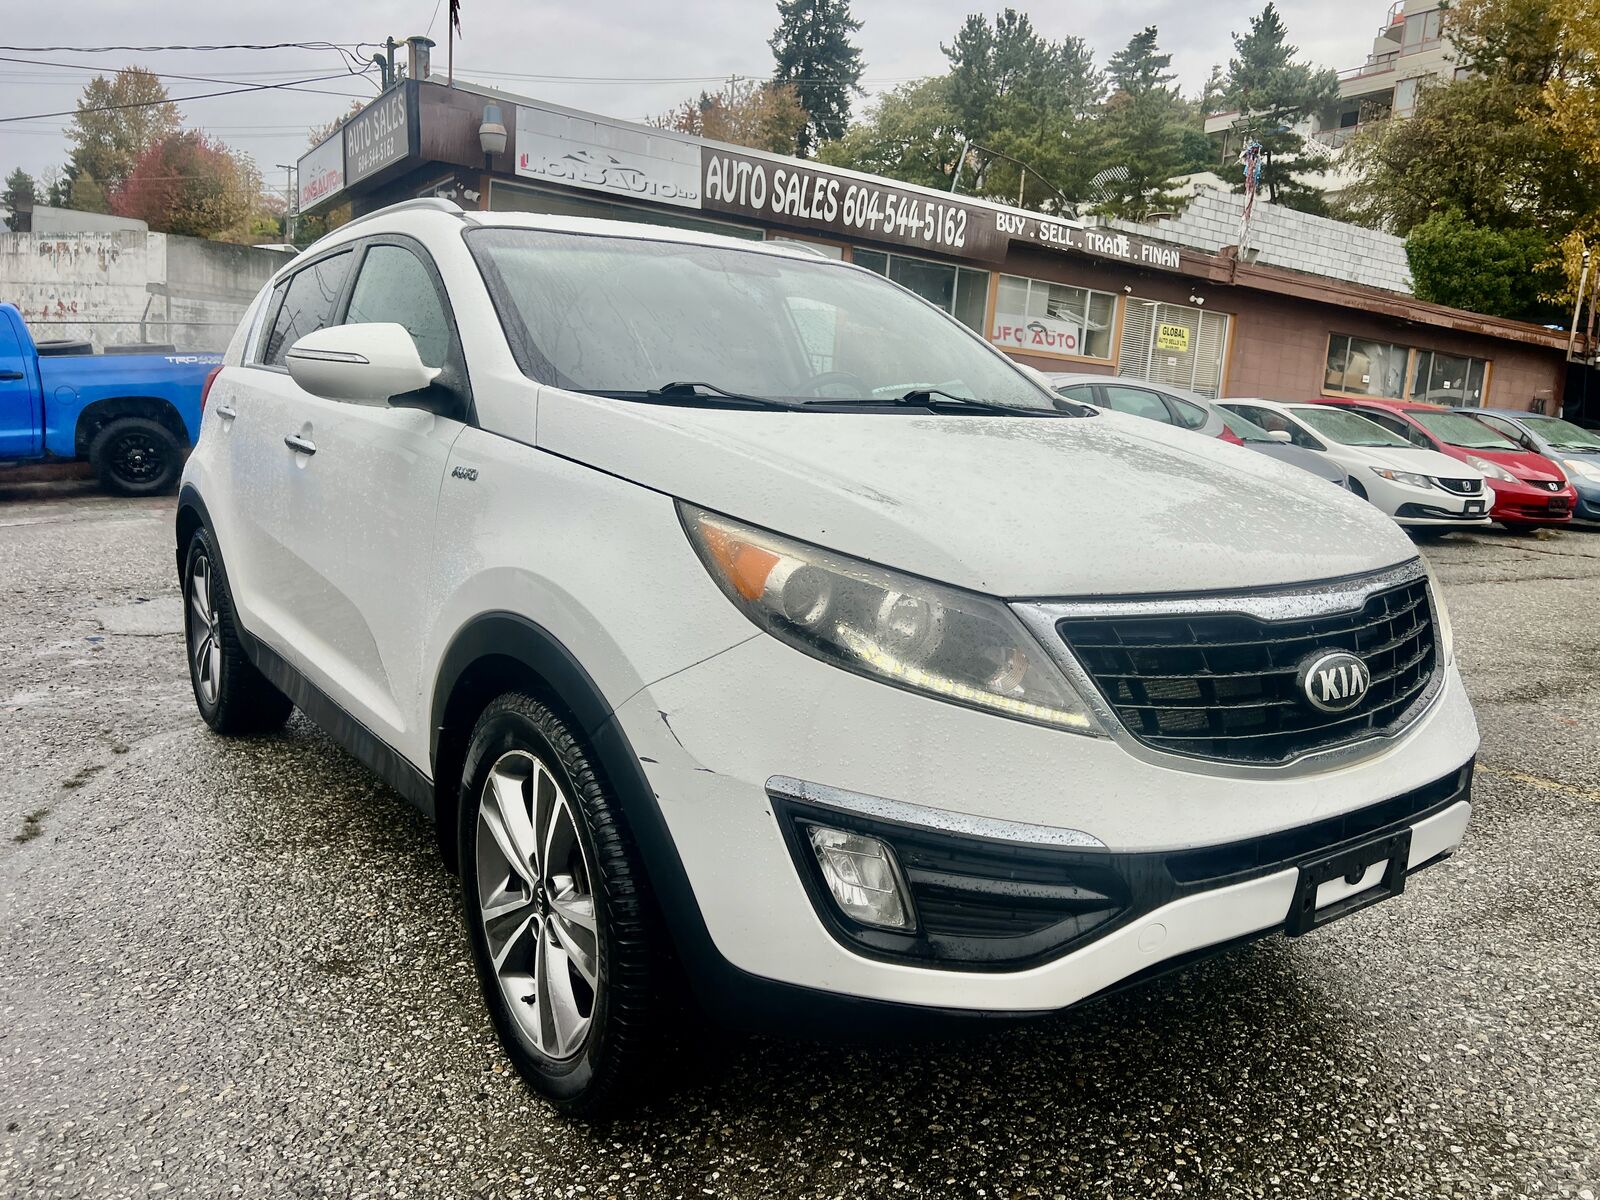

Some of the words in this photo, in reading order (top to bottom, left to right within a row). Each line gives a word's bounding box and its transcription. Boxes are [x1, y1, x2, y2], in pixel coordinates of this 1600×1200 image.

[348, 117, 371, 158] AUTO
[374, 92, 405, 141] SALES
[706, 154, 767, 210] AUTO
[771, 168, 840, 223] SALES
[842, 184, 967, 248] 604-544-5162
[995, 212, 1026, 235] BUY
[1039, 221, 1074, 247] SELL
[1085, 232, 1131, 258] TRADE
[1141, 244, 1180, 269] FINAN
[1032, 330, 1076, 349] AUTO
[1162, 326, 1185, 338] GLOBAL
[164, 356, 198, 365] TRD
[1318, 663, 1364, 702] KIA
